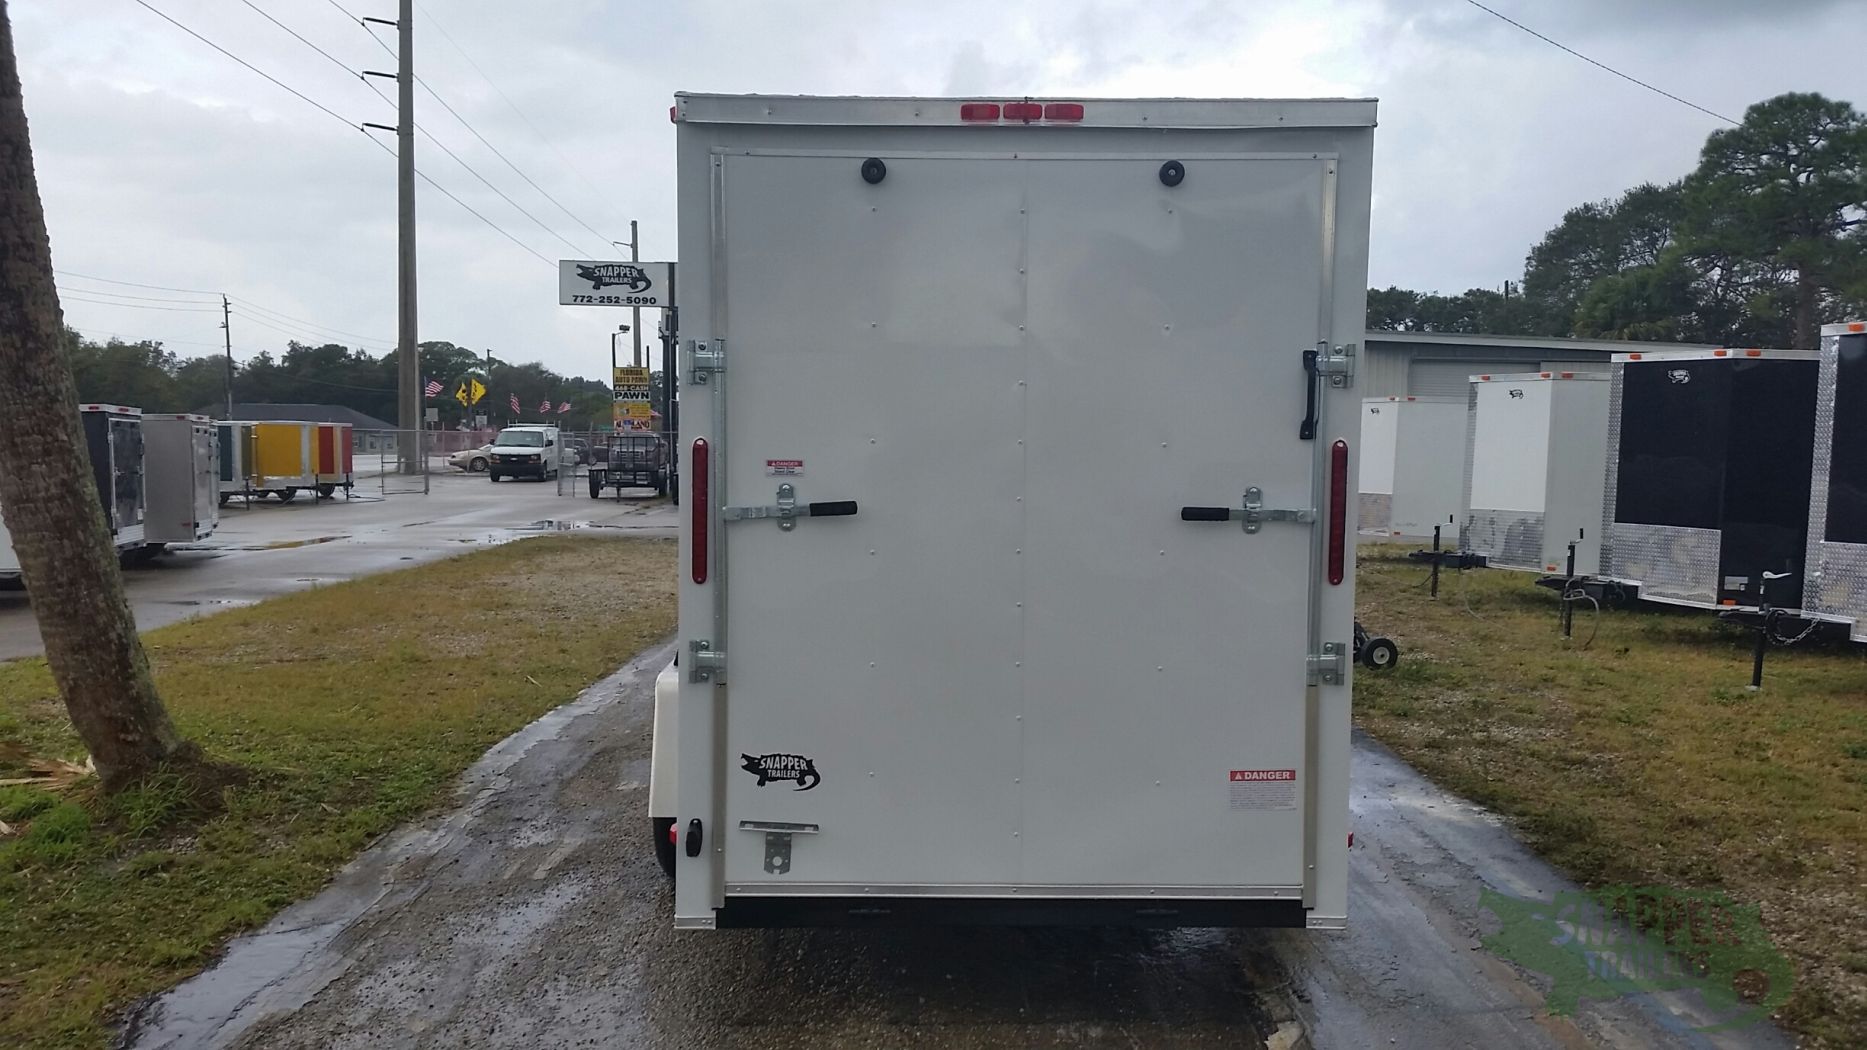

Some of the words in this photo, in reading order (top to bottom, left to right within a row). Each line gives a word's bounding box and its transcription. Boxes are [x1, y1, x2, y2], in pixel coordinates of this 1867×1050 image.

[593, 266, 640, 278] SNAPPER
[602, 276, 633, 284] TRAILERS
[572, 295, 657, 305] 772-252-5090
[614, 391, 650, 400] PAWN
[759, 756, 808, 770] SNAPPER
[767, 769, 800, 778] TRAILERS
[1244, 771, 1290, 780] DANGER
